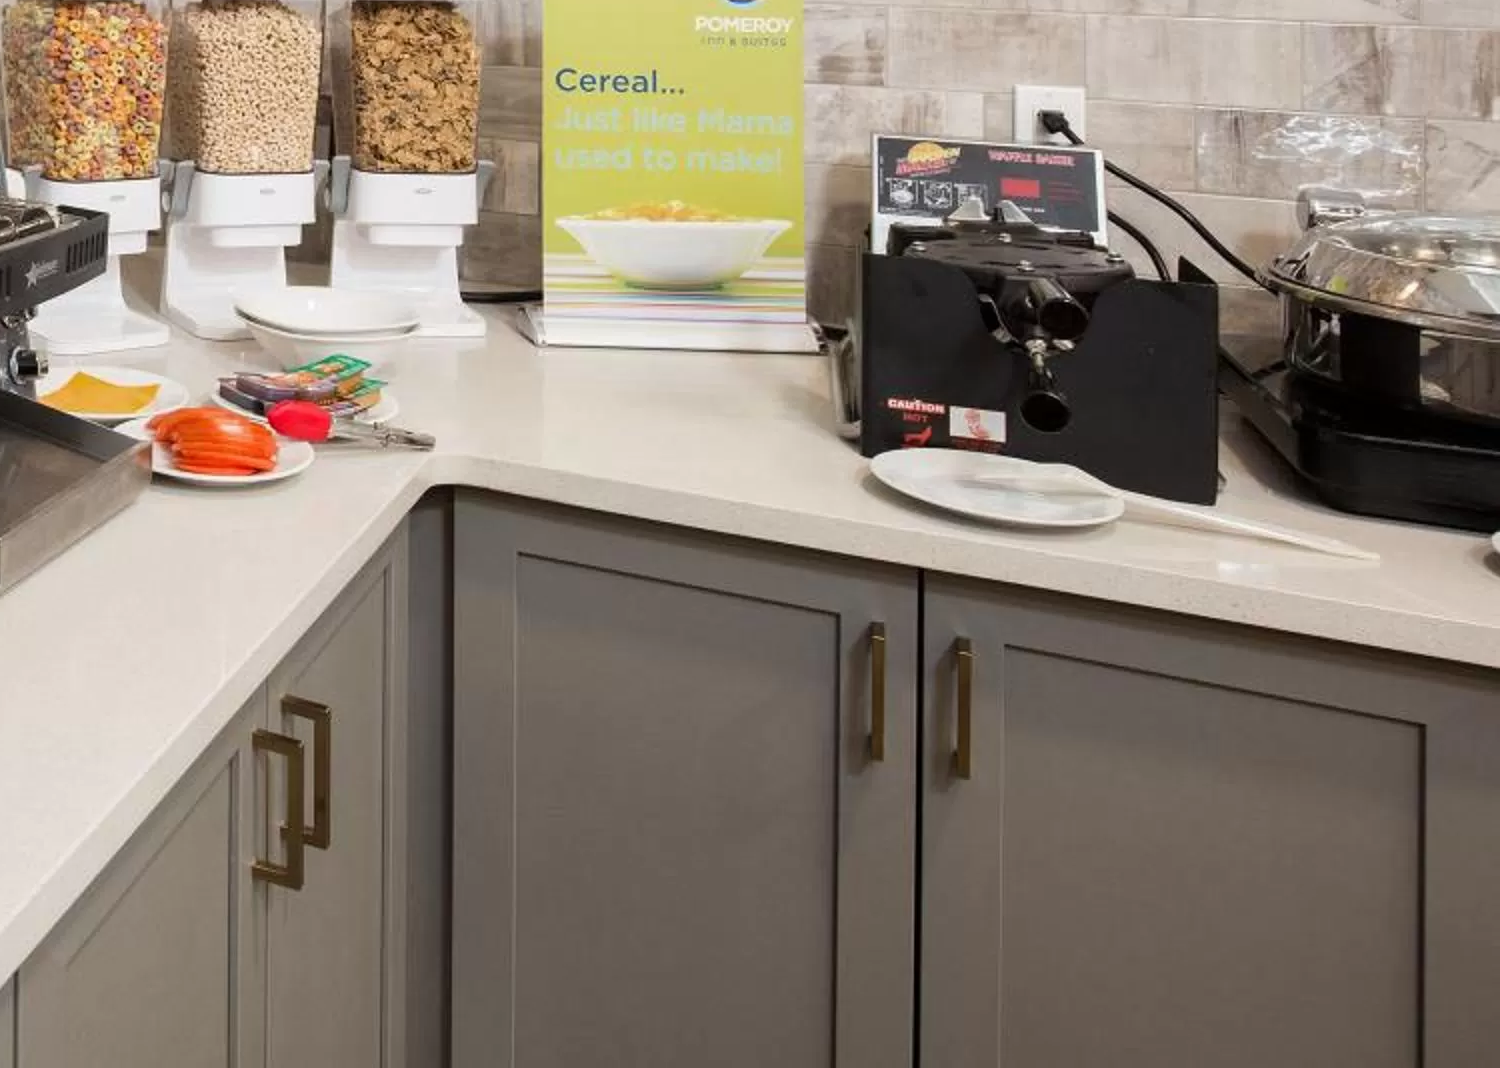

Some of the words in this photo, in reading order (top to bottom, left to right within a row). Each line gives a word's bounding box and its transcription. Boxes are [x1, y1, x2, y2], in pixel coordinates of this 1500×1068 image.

[694, 16, 795, 33] POMEROY
[554, 67, 685, 94] Cereal...
[556, 106, 620, 134] Just
[633, 106, 686, 134] like
[698, 109, 794, 135] Mama
[554, 142, 634, 172] used
[641, 148, 677, 172] to
[887, 397, 946, 415] CAUTION
